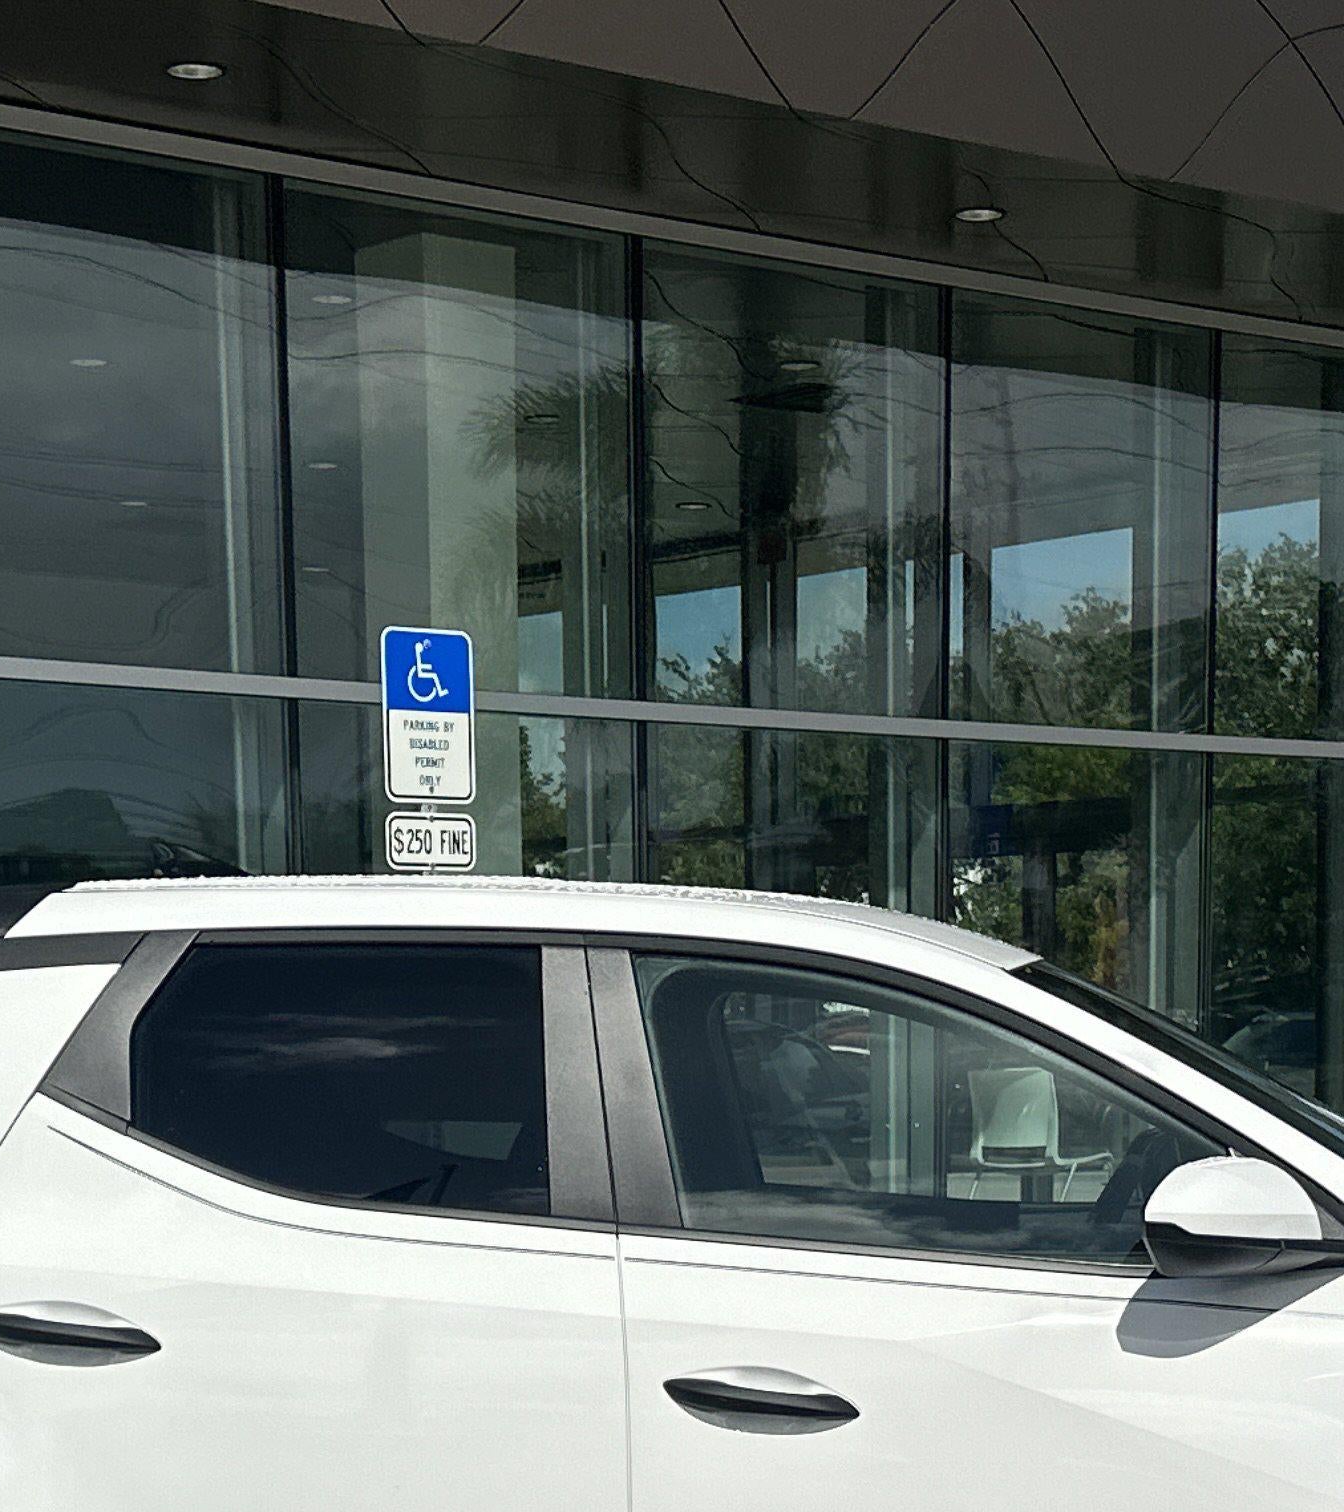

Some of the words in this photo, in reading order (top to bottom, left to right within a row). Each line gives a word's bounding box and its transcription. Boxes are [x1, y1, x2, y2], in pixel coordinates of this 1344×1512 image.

[415, 756, 445, 768] PERMIT
[393, 826, 433, 857] $250
[440, 828, 470, 855] FINE
